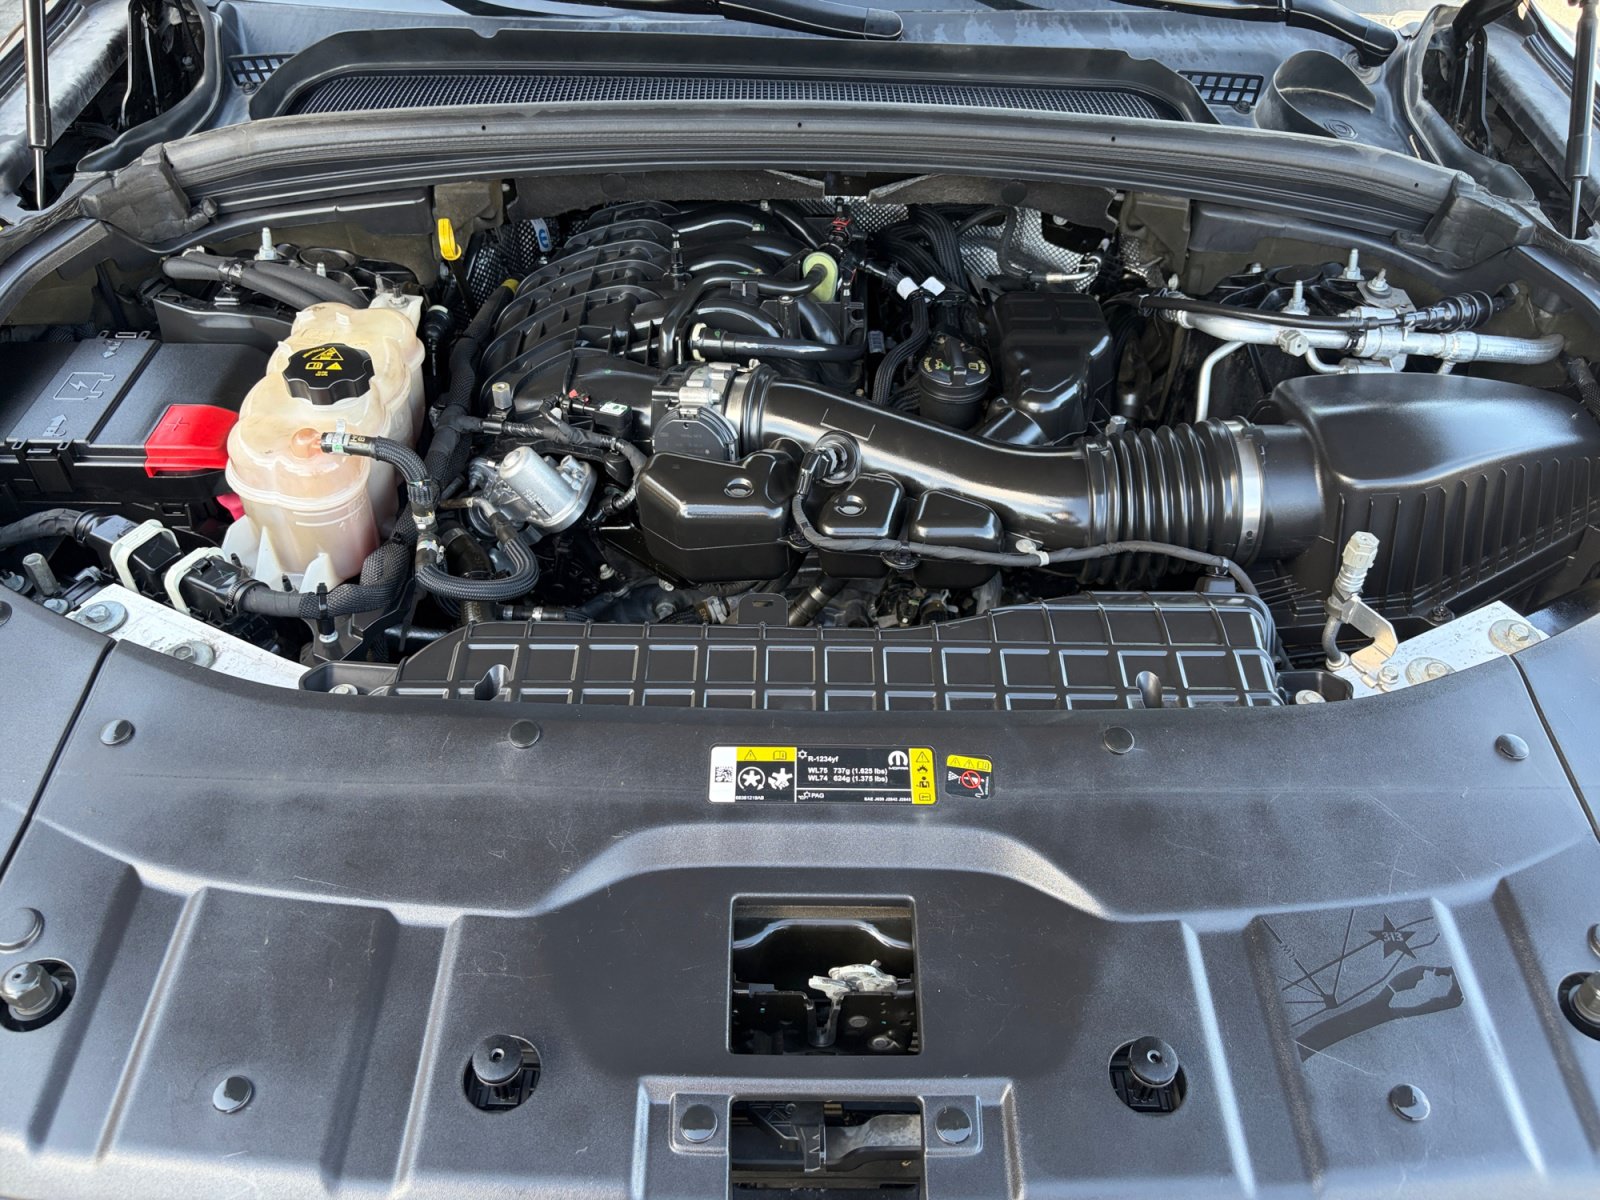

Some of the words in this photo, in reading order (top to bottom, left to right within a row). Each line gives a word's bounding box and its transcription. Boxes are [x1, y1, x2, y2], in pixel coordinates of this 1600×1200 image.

[833, 767, 851, 775] 737g
[874, 767, 888, 776] lbs)
[833, 775, 851, 783] 624g
[852, 775, 873, 783] (1.375
[874, 775, 888, 784] lbs)
[1381, 931, 1404, 942] 313
